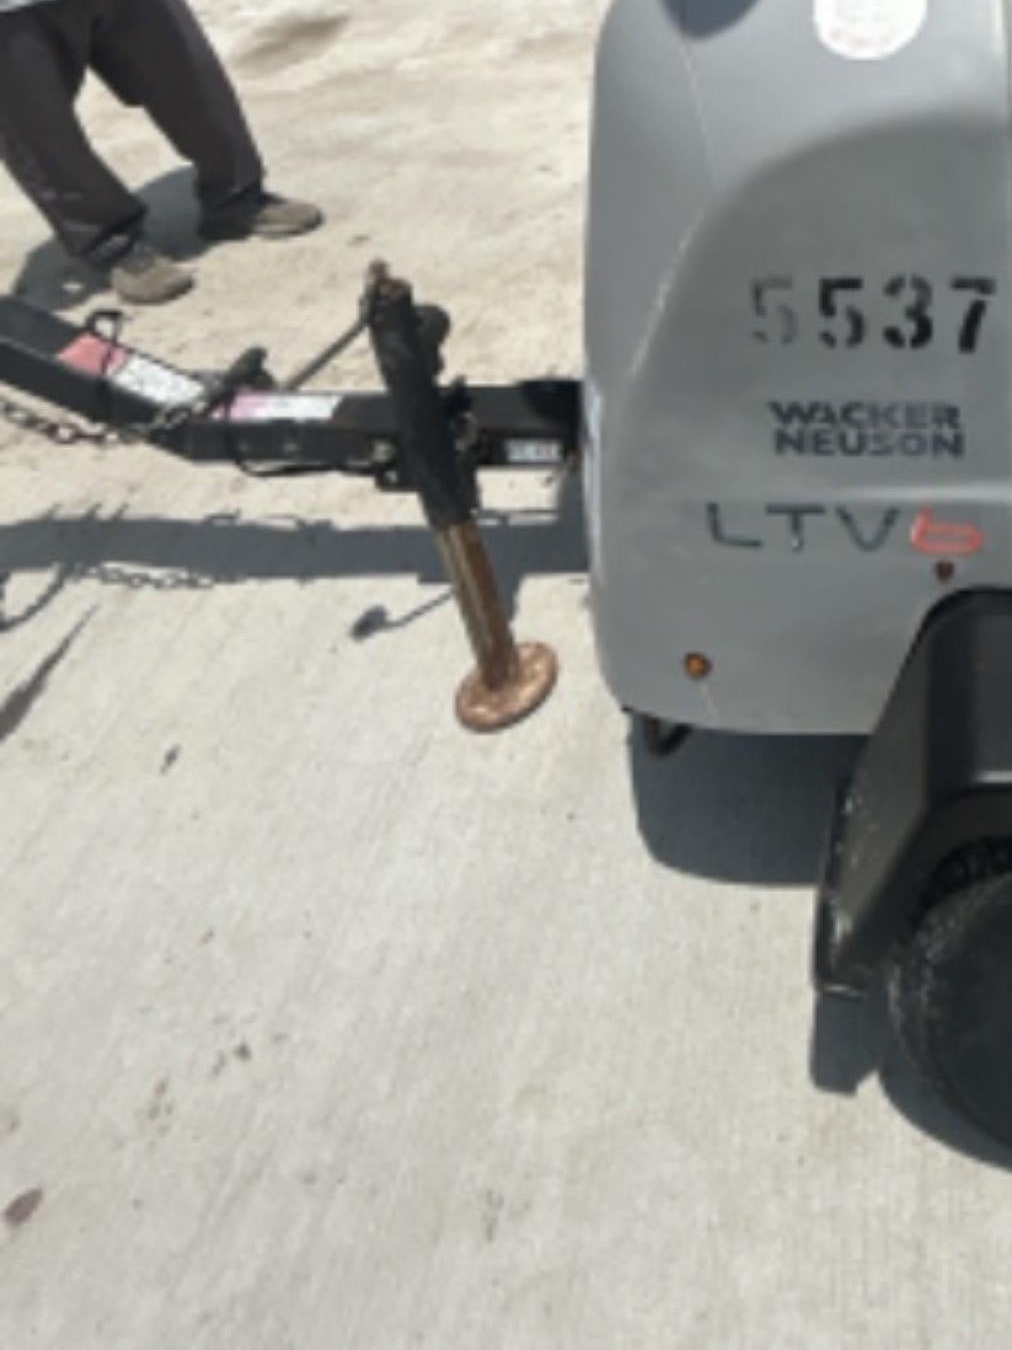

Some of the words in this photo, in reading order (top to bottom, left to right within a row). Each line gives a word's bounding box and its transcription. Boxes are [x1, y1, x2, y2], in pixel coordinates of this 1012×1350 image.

[751, 274, 998, 355] 5537
[767, 400, 962, 430] WACKER
[773, 428, 965, 459] NEUSON
